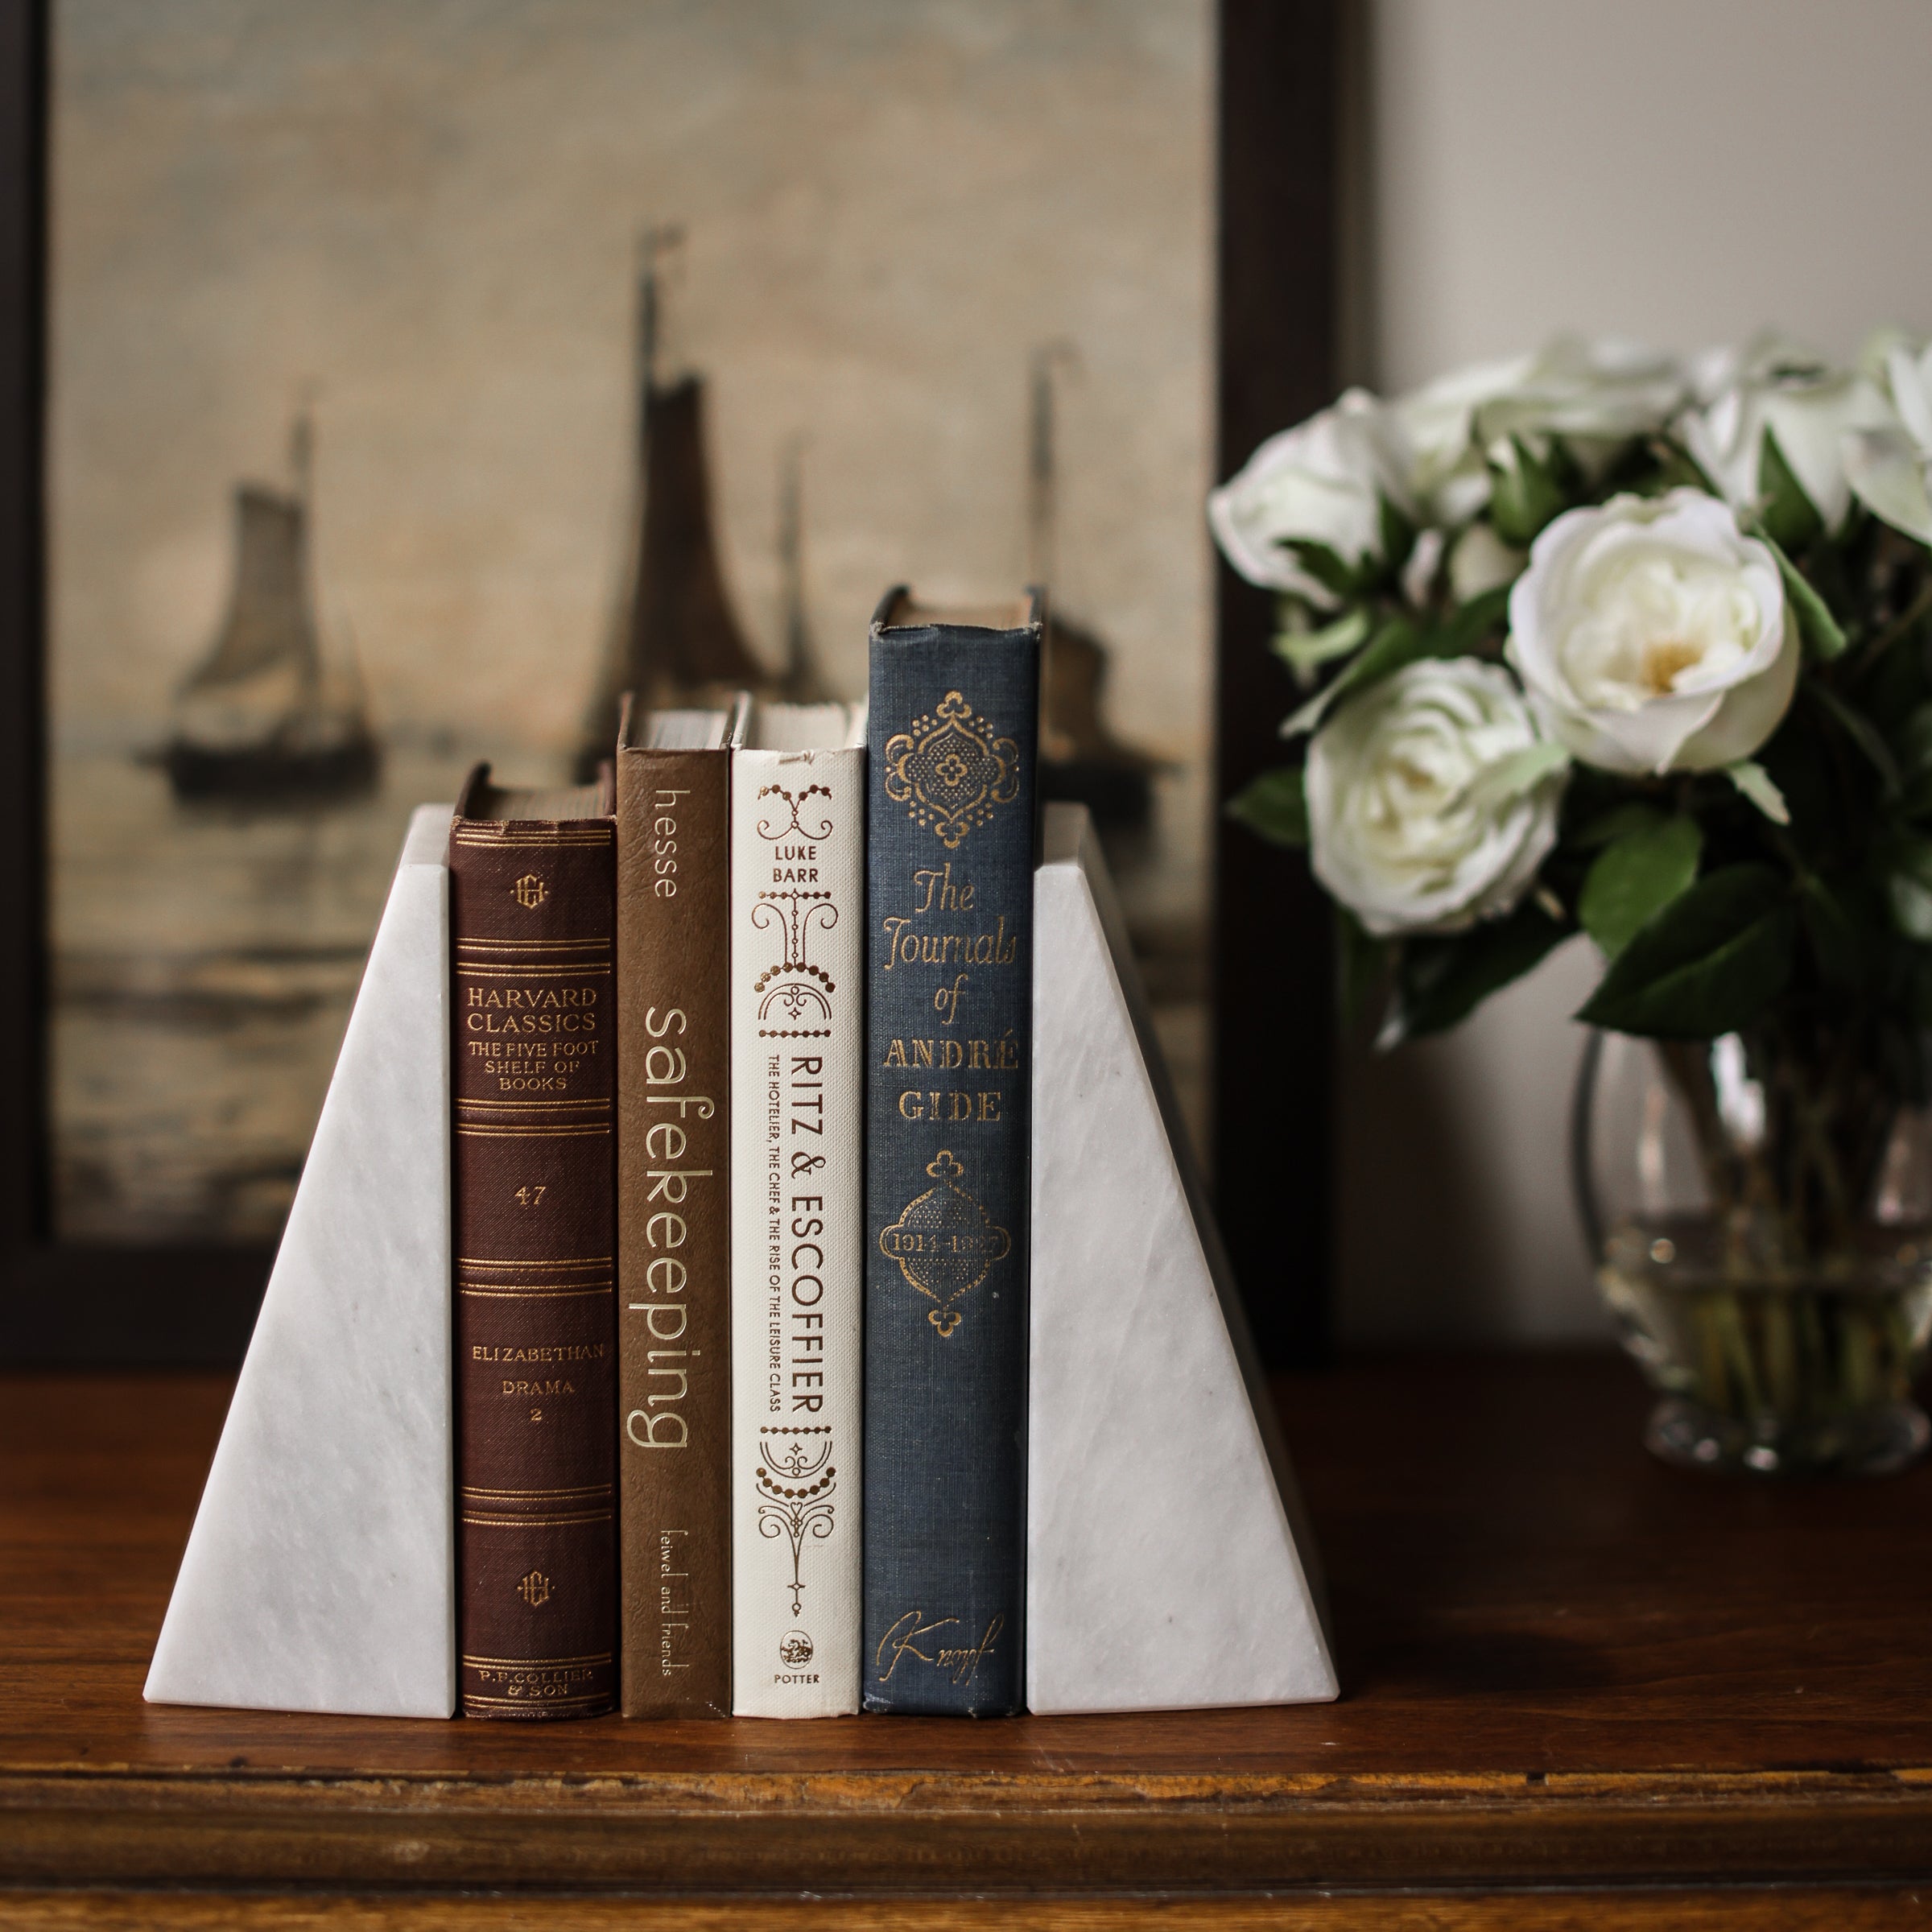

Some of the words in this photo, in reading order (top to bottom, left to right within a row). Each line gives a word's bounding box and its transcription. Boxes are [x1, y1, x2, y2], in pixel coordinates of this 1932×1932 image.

[654, 790, 691, 897] hesse
[775, 846, 817, 861] LUKE
[773, 868, 819, 882] BARR
[914, 862, 975, 912] The
[883, 915, 1017, 969] Journals
[467, 988, 597, 1008] HARVARD
[935, 973, 968, 1025] of
[467, 1013, 596, 1034] CLASSICS
[469, 1041, 502, 1057] THE
[506, 1042, 547, 1057] FIVE
[553, 1040, 599, 1056] FOOT
[883, 1029, 1018, 1070] ANDRÉ
[485, 1061, 546, 1074] SHELF
[554, 1060, 580, 1073] OF
[769, 1055, 779, 1077] THE
[499, 1077, 567, 1091] BOOKS
[791, 1056, 823, 1135] RITZ
[766, 1081, 780, 1142] HOTELIER,
[898, 1091, 1001, 1121] GIDE
[769, 1146, 779, 1169] THE
[791, 1151, 826, 1179] &
[514, 1186, 547, 1205] 47
[769, 1173, 780, 1203] CHEF
[769, 1207, 779, 1215] &
[626, 1006, 715, 1448] safekeeping
[769, 1218, 780, 1241] THE
[770, 1245, 780, 1270] RISE
[770, 1275, 780, 1292] OF
[770, 1295, 780, 1318] THE
[791, 1196, 824, 1412] ESCOFFIER
[473, 1344, 604, 1362] ELIZABETHAN
[770, 1323, 780, 1369] LEISURE
[502, 1380, 576, 1395] DRAMA
[770, 1373, 780, 1412] CLASS
[530, 1409, 543, 1421] 2
[661, 1530, 688, 1579] feiwel
[661, 1587, 688, 1613] and
[662, 1623, 689, 1676] friends
[877, 1611, 1004, 1686] Knopf
[508, 1685, 522, 1696] &
[529, 1684, 568, 1696] SON
[774, 1674, 819, 1684] POTTER
